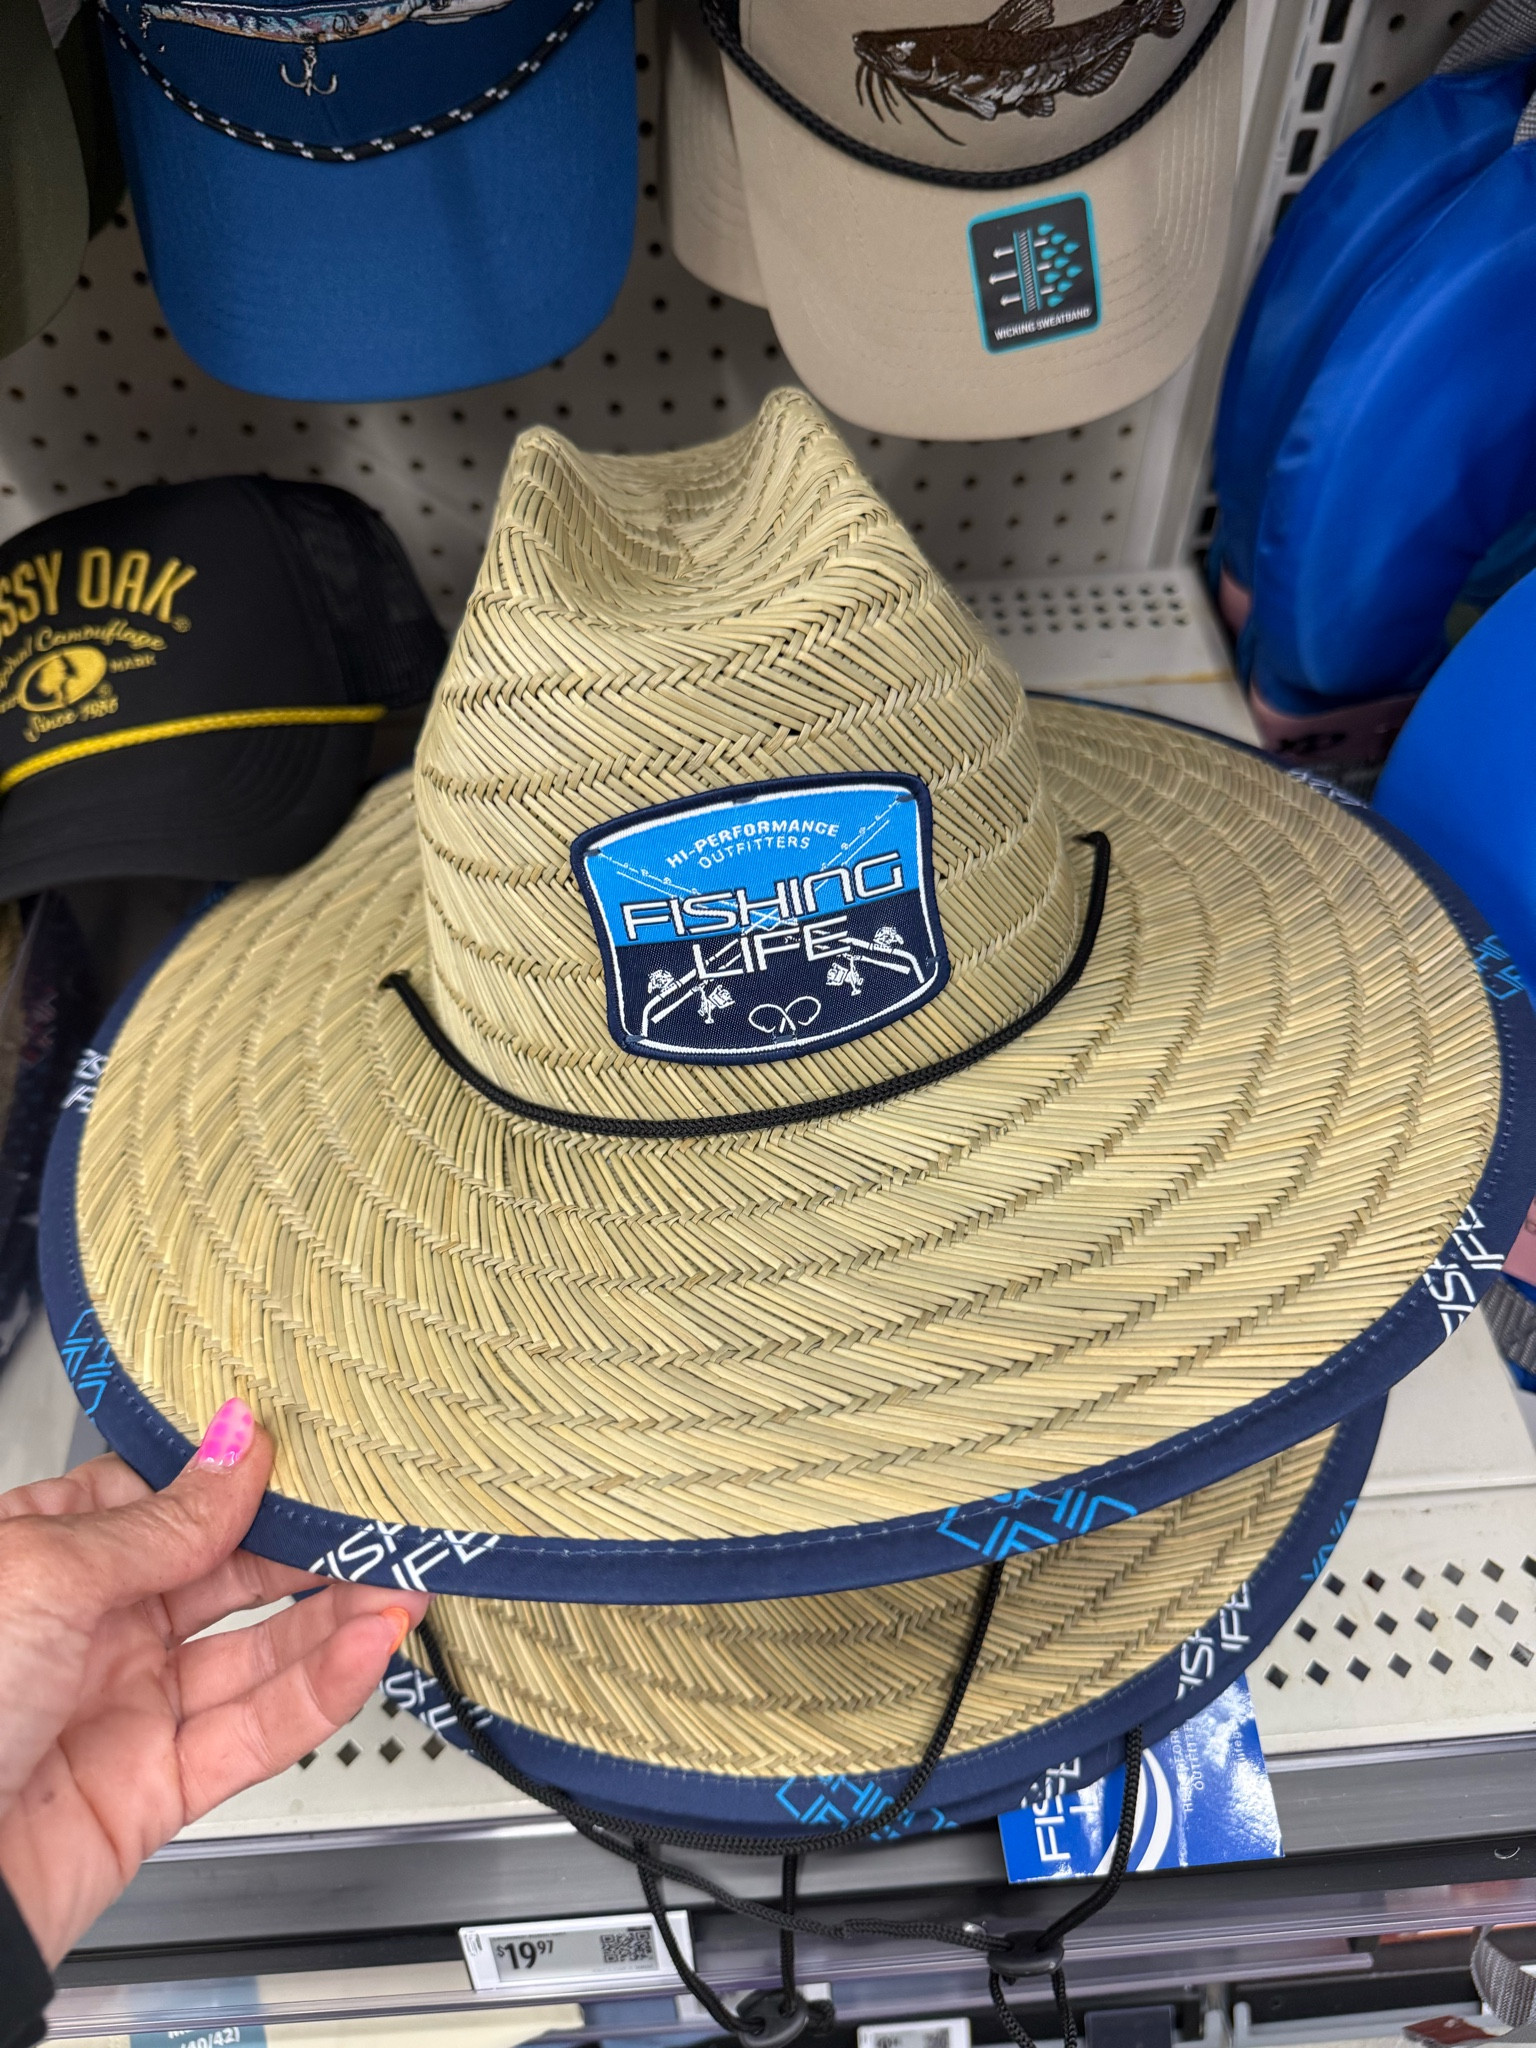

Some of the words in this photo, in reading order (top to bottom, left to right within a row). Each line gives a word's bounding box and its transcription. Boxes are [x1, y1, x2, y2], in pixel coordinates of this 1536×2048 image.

[994, 321, 1036, 341] WICKING
[1036, 307, 1092, 330] SWEATBAND
[77, 547, 198, 623] OAK
[23, 709, 78, 742] Since
[666, 819, 840, 868] HI-PERFORMANCE
[698, 836, 811, 869] OUTFITTERS
[620, 851, 904, 941] FISHING
[693, 915, 851, 980] LIFE
